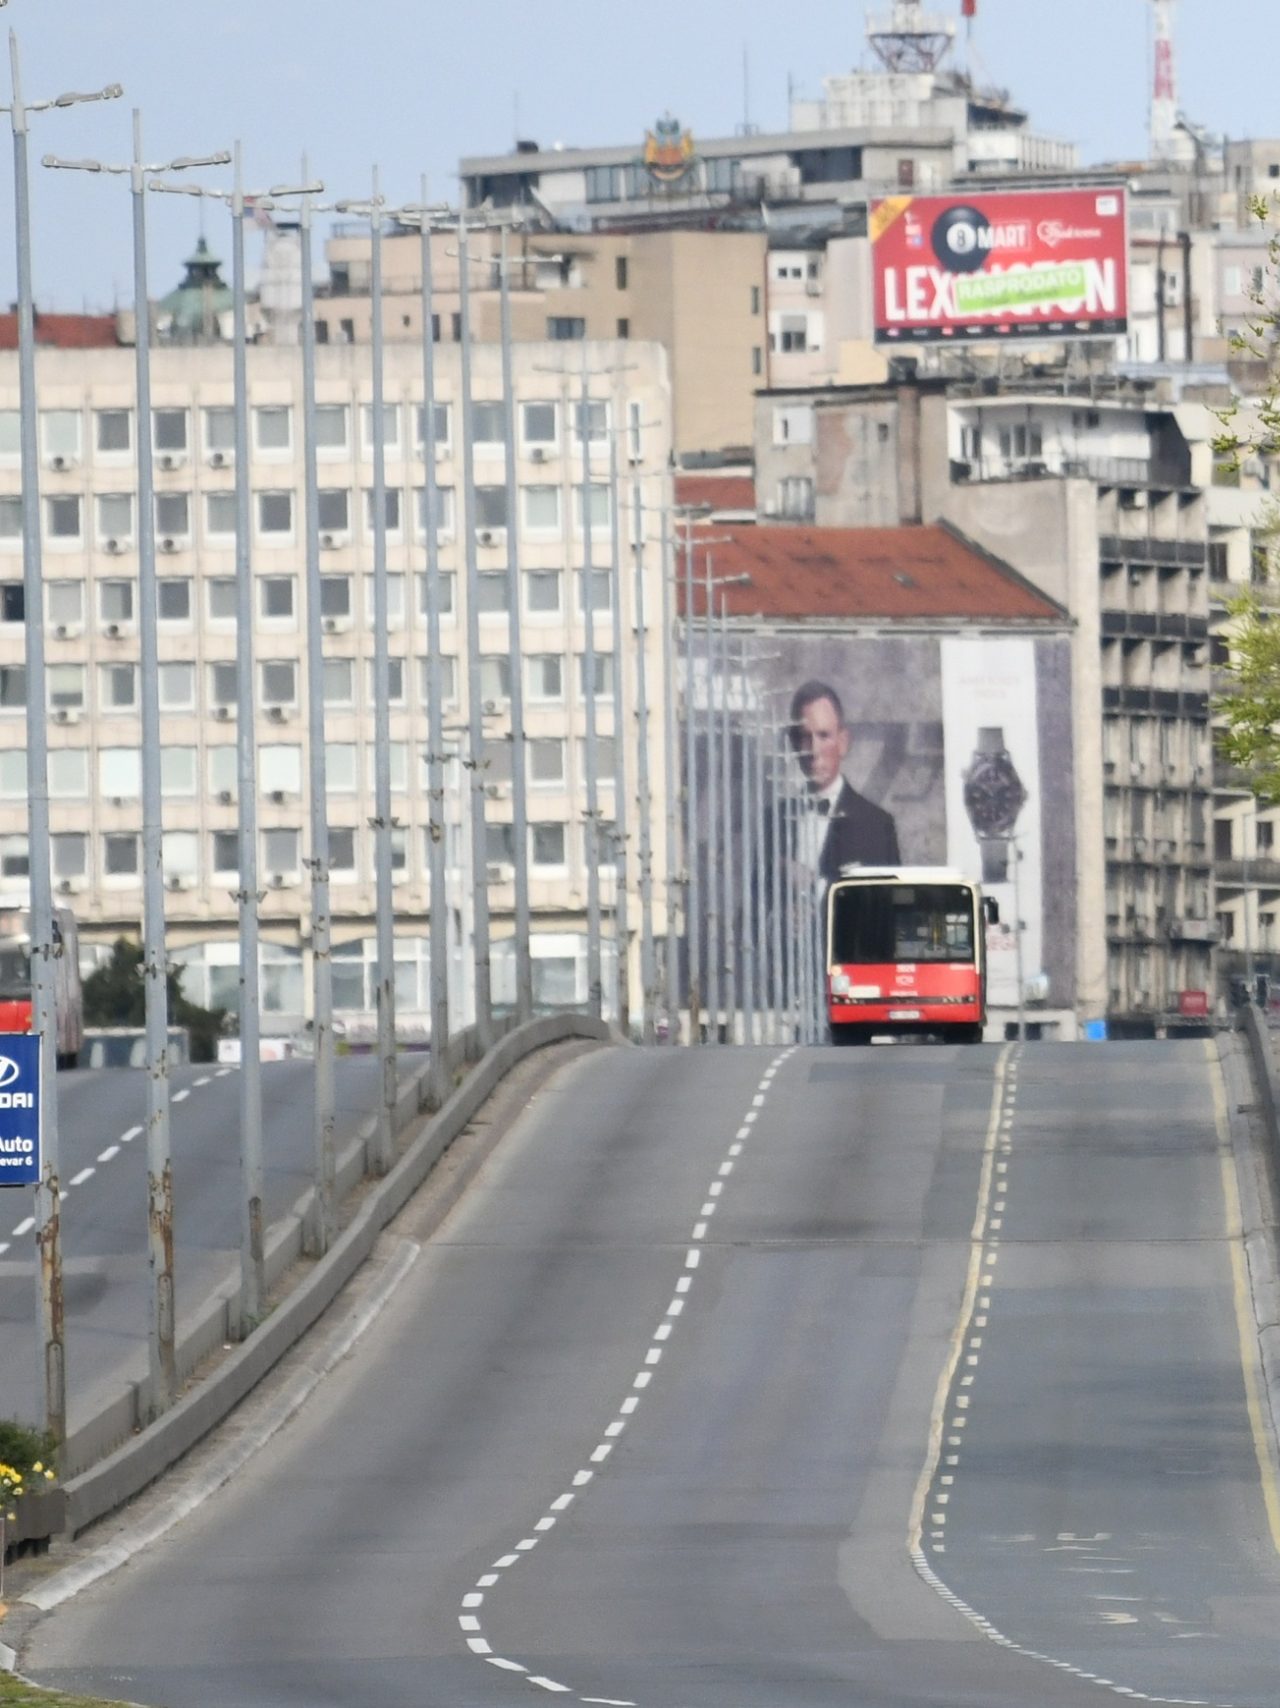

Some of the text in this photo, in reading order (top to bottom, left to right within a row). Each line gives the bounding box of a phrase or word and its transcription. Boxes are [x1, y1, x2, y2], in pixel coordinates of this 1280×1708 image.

[977, 224, 1026, 249] MART
[958, 270, 1082, 299] RASPRODATO
[25, 1156, 33, 1166] 6
